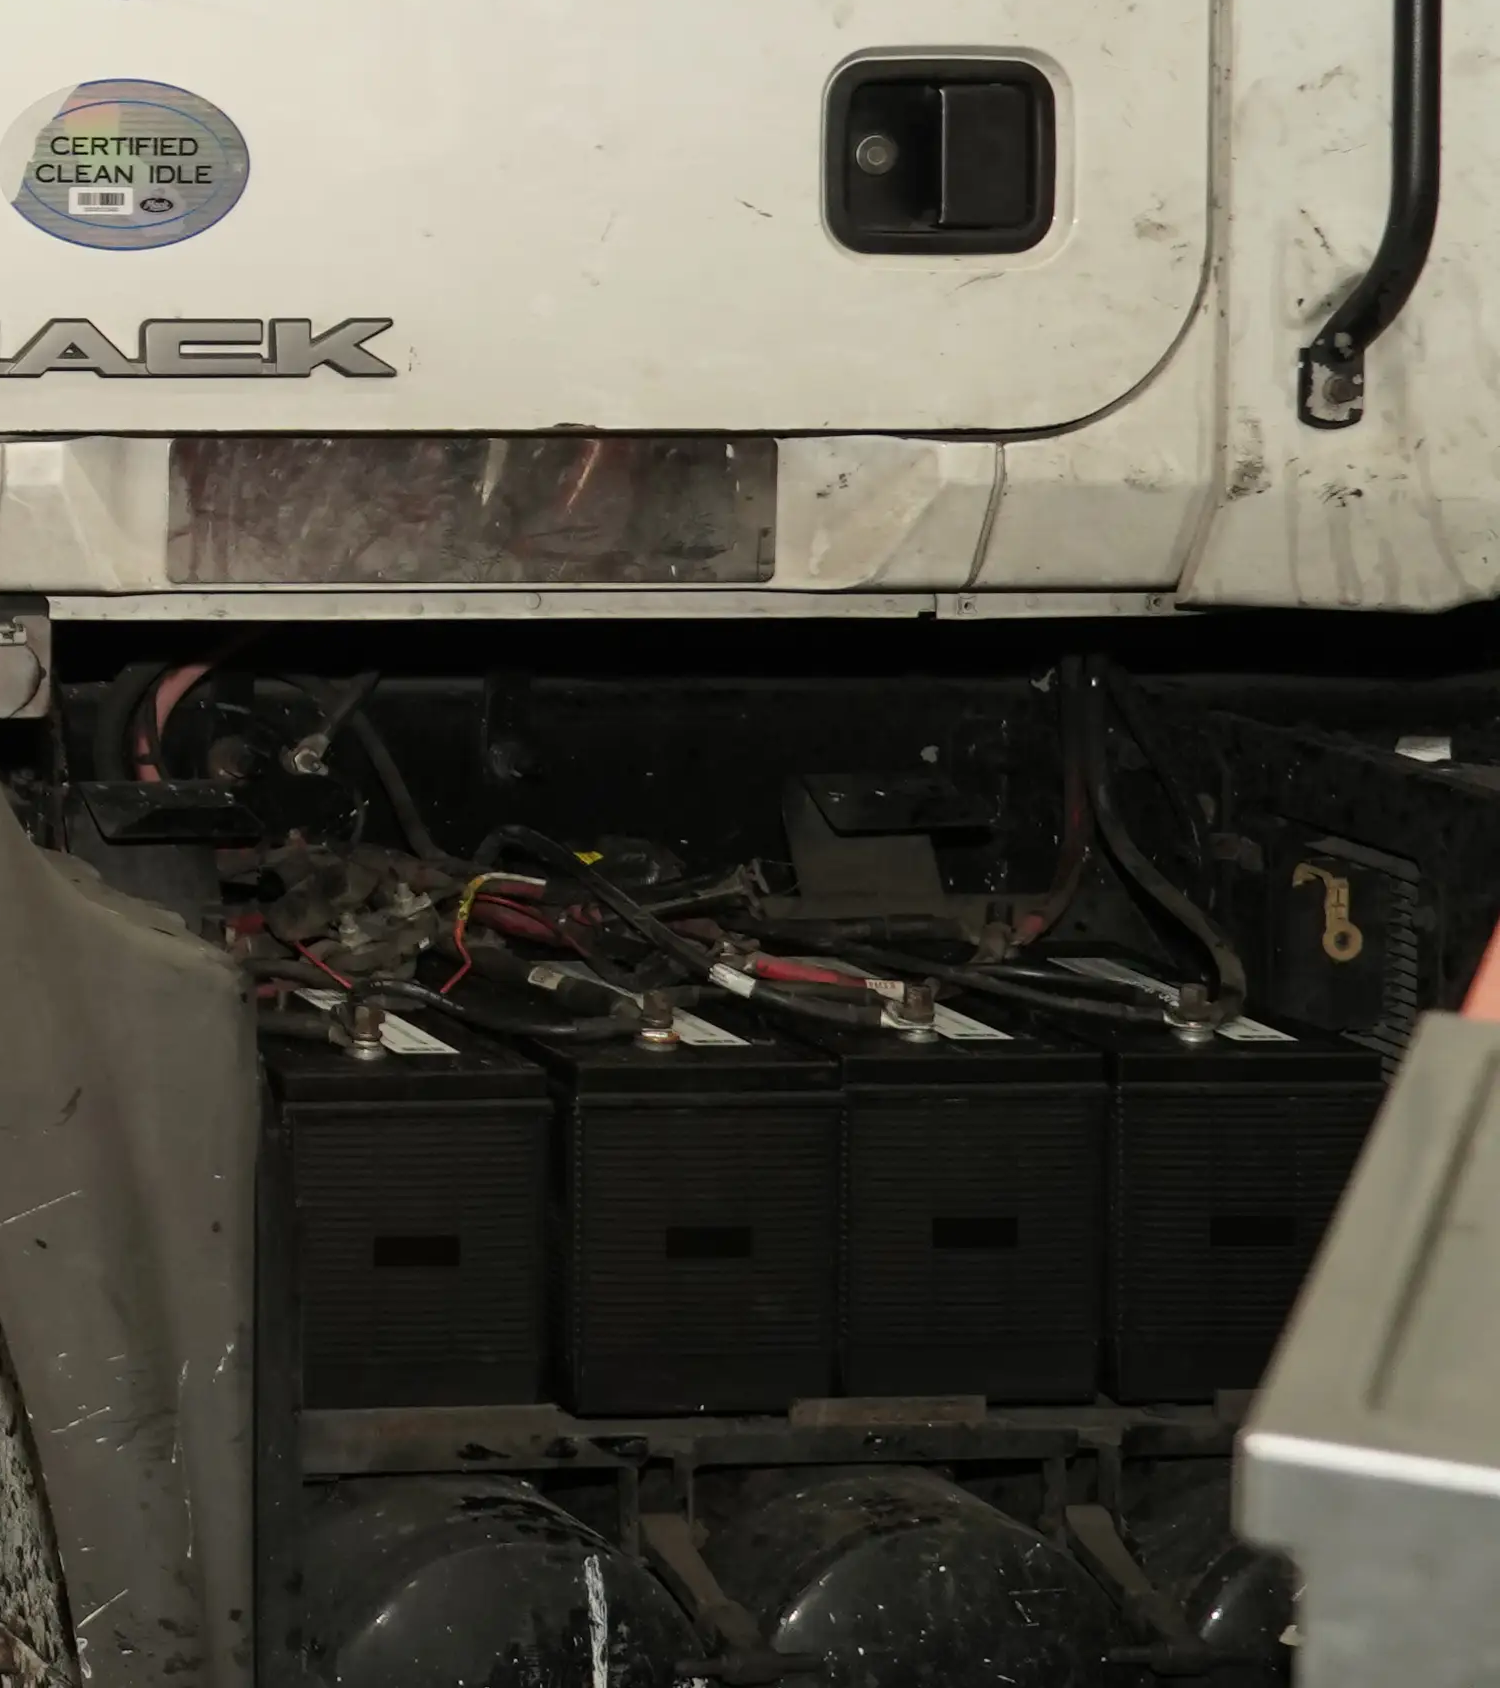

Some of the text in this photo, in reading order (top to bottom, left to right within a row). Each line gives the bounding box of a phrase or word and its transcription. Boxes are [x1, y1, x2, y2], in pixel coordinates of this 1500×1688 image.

[50, 136, 199, 157] CERTIFIED
[35, 163, 212, 185] CLEAN IDLE
